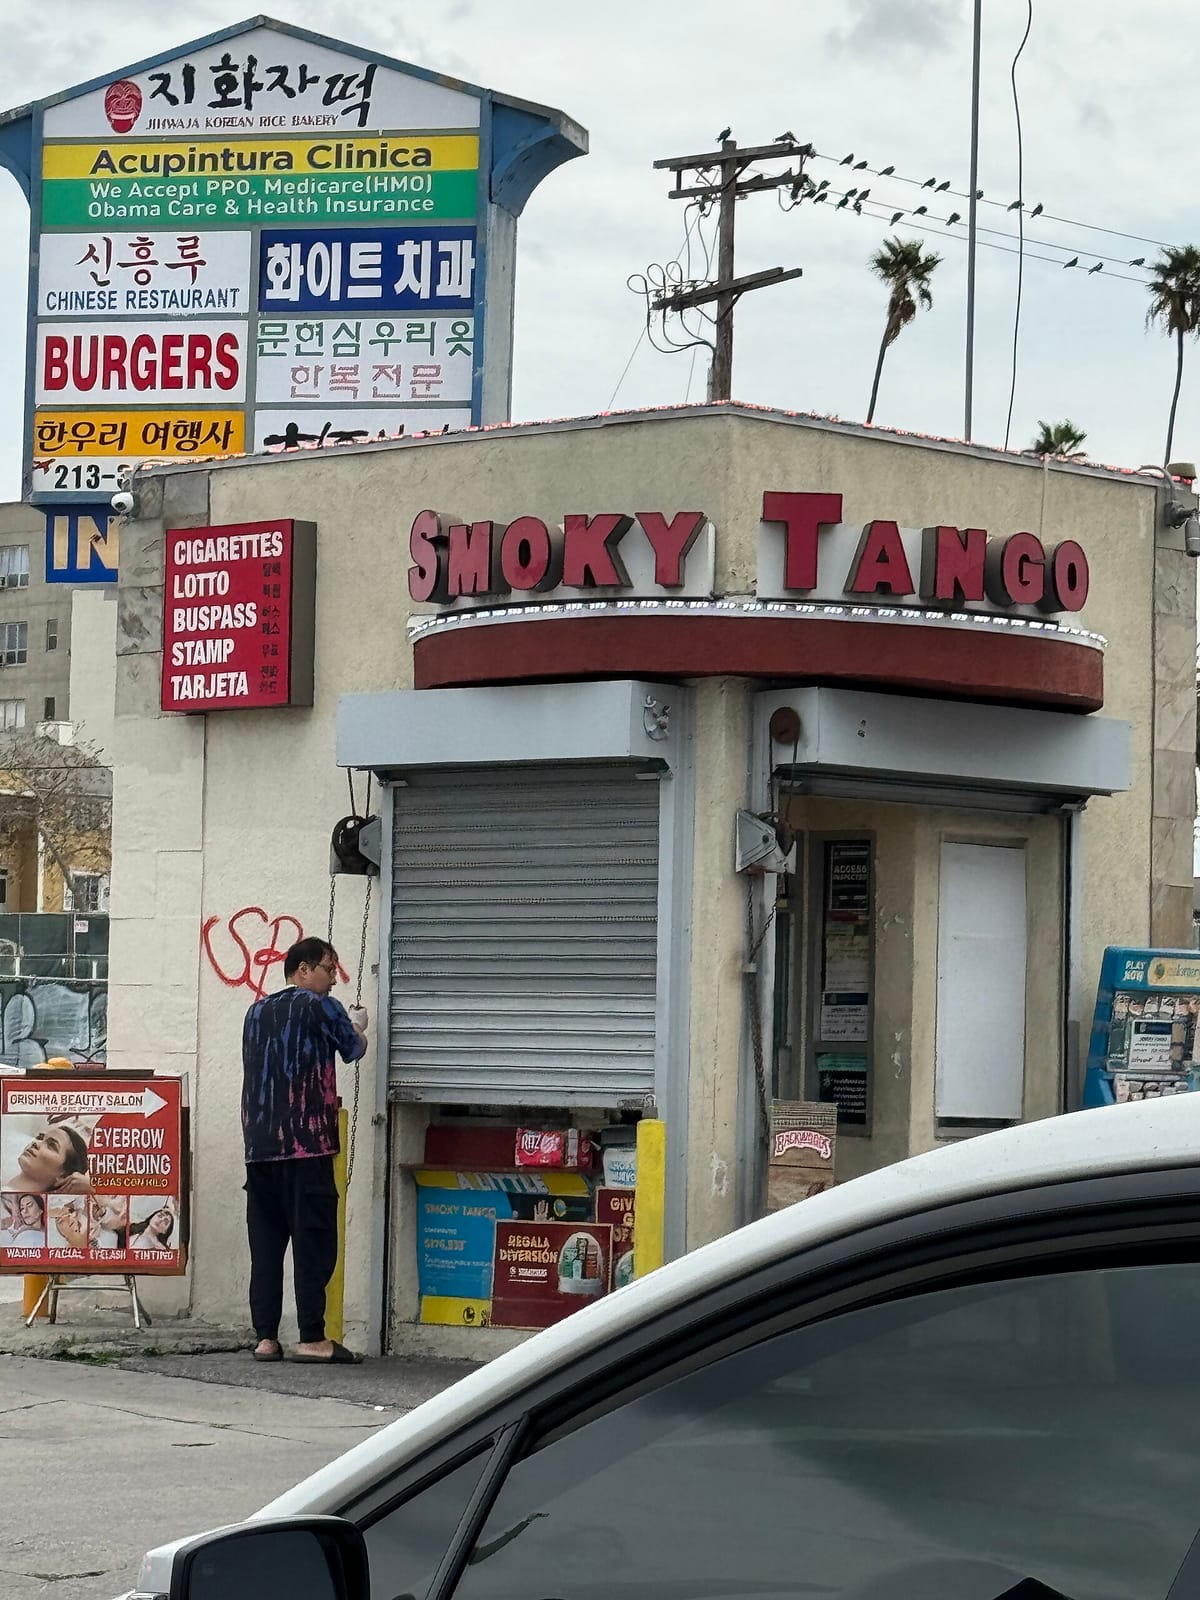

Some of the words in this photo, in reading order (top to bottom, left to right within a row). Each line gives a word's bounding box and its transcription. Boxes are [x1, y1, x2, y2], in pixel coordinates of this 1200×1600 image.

[205, 116, 254, 129] KOREAN
[259, 115, 287, 128] RICE
[292, 114, 340, 127] BAKERY
[89, 146, 294, 178] Acupintura
[306, 142, 432, 170] Clinica
[90, 182, 122, 198] We
[128, 182, 199, 200] Accept
[88, 202, 161, 217] Obama
[168, 201, 217, 216] Care
[224, 199, 240, 215] &
[247, 197, 318, 214] Health
[326, 196, 434, 213] Insurance
[74, 235, 207, 287] 신흥루
[46, 290, 118, 310] CHINESE
[126, 287, 240, 310] RESTAURANT
[44, 332, 240, 392] BURGERS
[37, 420, 128, 452] 한우리
[141, 419, 234, 452] 여행사
[174, 531, 283, 565] CIGARETTES
[407, 508, 705, 605] SMOKY
[762, 491, 1090, 613] TANGO
[173, 570, 230, 599] LOTTO
[173, 602, 258, 632] BUSPASS
[172, 638, 235, 666] STAMP
[171, 672, 249, 700] TARJETA
[61, 1094, 104, 1107] BEAUTY
[106, 1095, 144, 1107] SALON
[93, 1127, 165, 1149] EYEBROW
[87, 1153, 171, 1175] THREADING
[610, 1197, 634, 1212] GIV
[508, 1234, 551, 1248] REGALA
